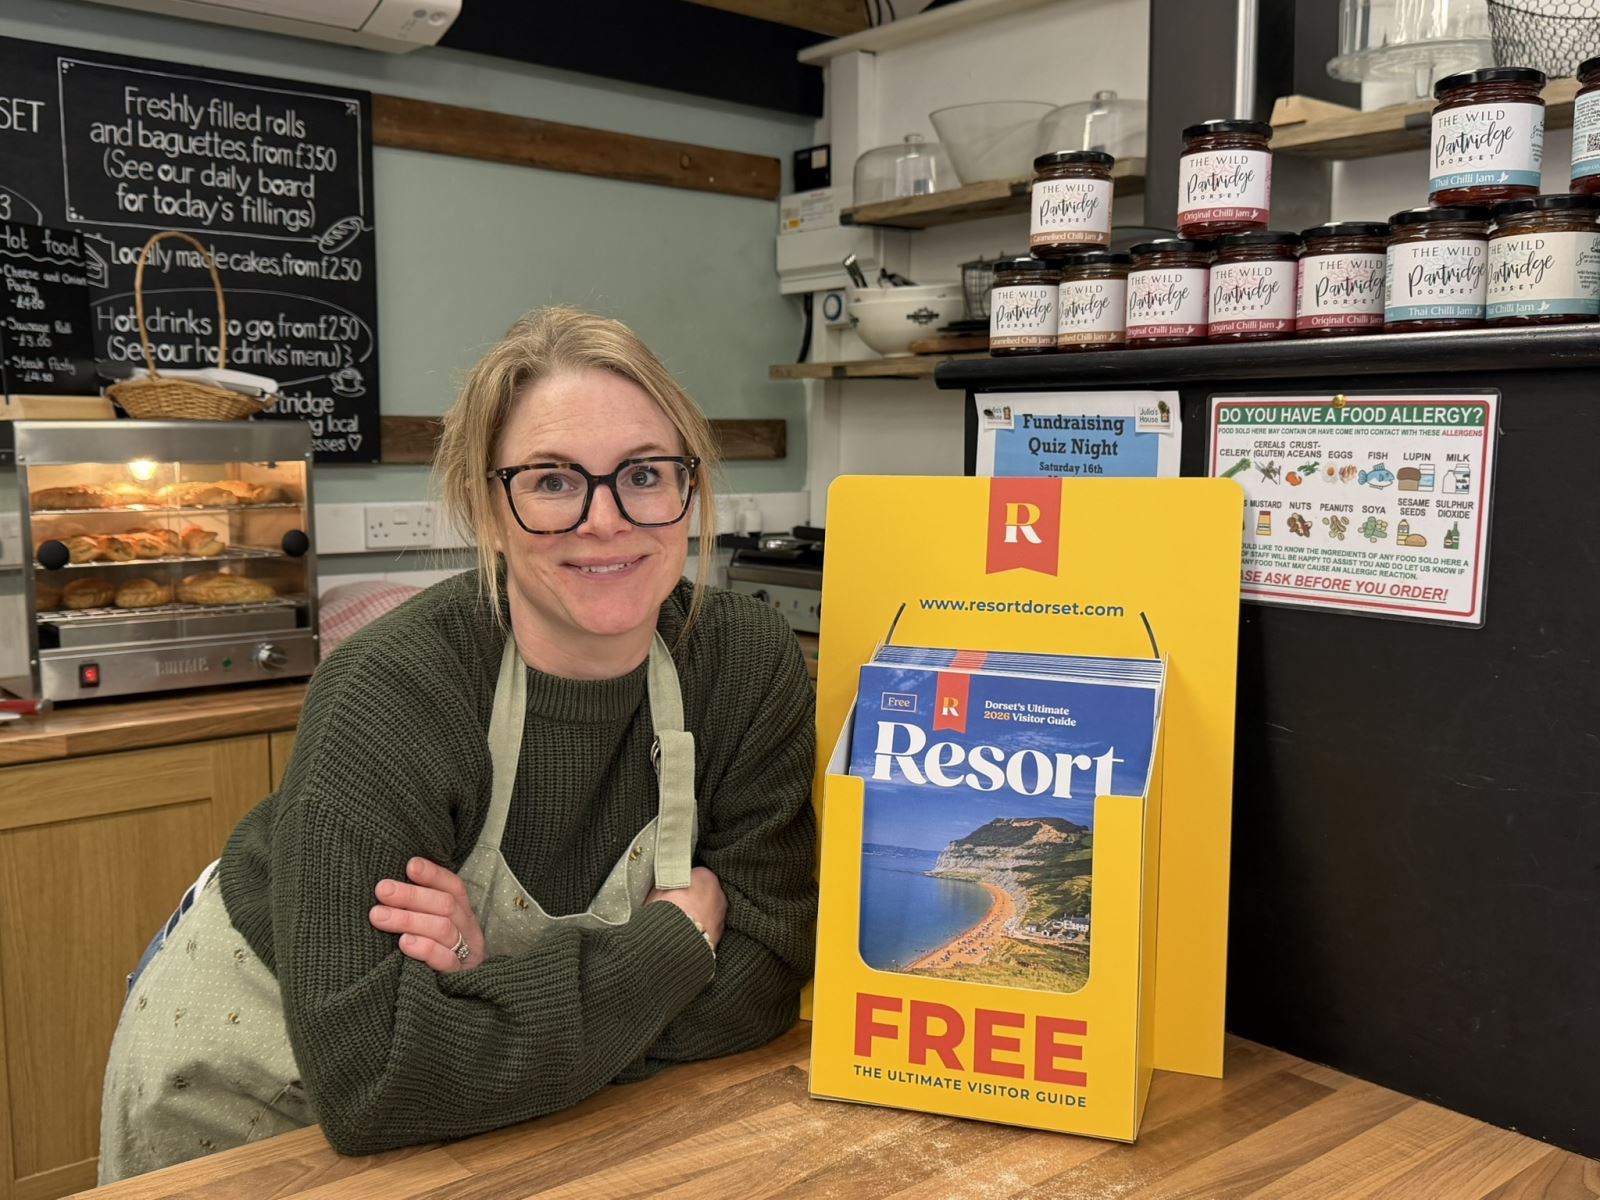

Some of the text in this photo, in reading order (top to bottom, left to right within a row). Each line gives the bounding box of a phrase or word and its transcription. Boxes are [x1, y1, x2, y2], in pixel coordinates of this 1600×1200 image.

[125, 86, 306, 138] Freshly filled rolls
[1439, 110, 1505, 128] THE WILD
[90, 118, 132, 146] and
[251, 135, 294, 167] from
[1435, 121, 1515, 168] Partridge
[1190, 155, 1249, 167] THE WILD
[1441, 154, 1495, 166] DORSET
[103, 147, 315, 199] (See our daily board
[1450, 174, 1473, 185] Chilli
[1475, 174, 1494, 185] Jam
[1042, 184, 1094, 194] THE WILD
[1187, 164, 1255, 204] Partridge
[115, 182, 317, 232] for today's fillings)
[1040, 192, 1099, 227] Partridge
[1184, 208, 1250, 221] Original Chilli Jam
[42, 228, 80, 258] food
[1067, 232, 1084, 240] Chilli
[1085, 232, 1097, 241] Jam
[1411, 246, 1481, 258] THE WILD
[1507, 239, 1545, 252] WILD
[111, 240, 173, 274] Locally
[175, 243, 229, 270] made
[281, 252, 320, 278] from
[1319, 259, 1383, 270] THE WILD
[1131, 274, 1183, 286] THE WILD
[1216, 267, 1272, 280] THE WILD
[1408, 257, 1487, 298] Partridge
[997, 290, 1047, 300] THE WILD
[1130, 283, 1190, 320] Partridge
[1214, 276, 1280, 315] Partridge
[1408, 306, 1473, 316] Thai Chilli Jam
[1516, 303, 1535, 312] Jam
[996, 299, 1054, 330] Partridge
[1311, 315, 1369, 326] Original Chilli
[96, 305, 140, 333] Hot
[145, 306, 213, 335] drinks
[277, 312, 317, 338] from
[1211, 320, 1275, 333] Original Chilli Jam
[1147, 326, 1185, 335] Chilli Jam
[157, 343, 193, 363] our
[290, 343, 341, 368] menu)
[1220, 407, 1483, 424] DO YOU HAVE A FOOD ALLERGY?
[327, 413, 360, 433] local
[1022, 413, 1125, 436] Fundraising
[1028, 437, 1118, 460] Quiz Night
[1254, 441, 1285, 449] CEREALS
[1219, 449, 1251, 457] CELERY
[1253, 449, 1285, 459] (GLUTEN)
[1286, 450, 1322, 458] ACEANS
[1328, 451, 1353, 459] EGGS
[1368, 451, 1388, 460] FISH
[1403, 452, 1431, 461] LUPIN
[1446, 453, 1470, 462] MILK
[1039, 462, 1103, 475] Saturday 16th
[1250, 500, 1282, 509] MUSTARD
[1289, 502, 1312, 510] NUTS
[1320, 503, 1354, 513] PEANUTS
[1398, 498, 1430, 507] SESAME
[1435, 499, 1474, 510] SULPHUR
[1361, 505, 1386, 514] SOYA
[1400, 507, 1426, 517] SEEDS
[1437, 509, 1471, 519] DIOXIDE
[1004, 502, 1043, 544] R
[1284, 545, 1305, 553] KNOW
[1306, 547, 1320, 555] THE
[1321, 548, 1366, 558] INGREDIENTS
[1418, 556, 1439, 564] SOLD
[1440, 558, 1461, 566] HERE
[1264, 572, 1292, 585] ASK
[1294, 575, 1352, 591] BEFORE
[1356, 580, 1386, 594] YOU
[1390, 584, 1449, 601] ORDER!
[919, 598, 1124, 617] www.resortdorset.com
[888, 697, 911, 708] Free
[941, 696, 959, 717] R
[984, 700, 1070, 716] Dorset's Ultimate
[984, 710, 1077, 727] 2026 Visitor Guide
[871, 720, 1125, 799] Resort
[853, 991, 1088, 1088] FREE
[853, 1064, 1088, 1108] THE ULTIMATE VISITOR GUIDE
